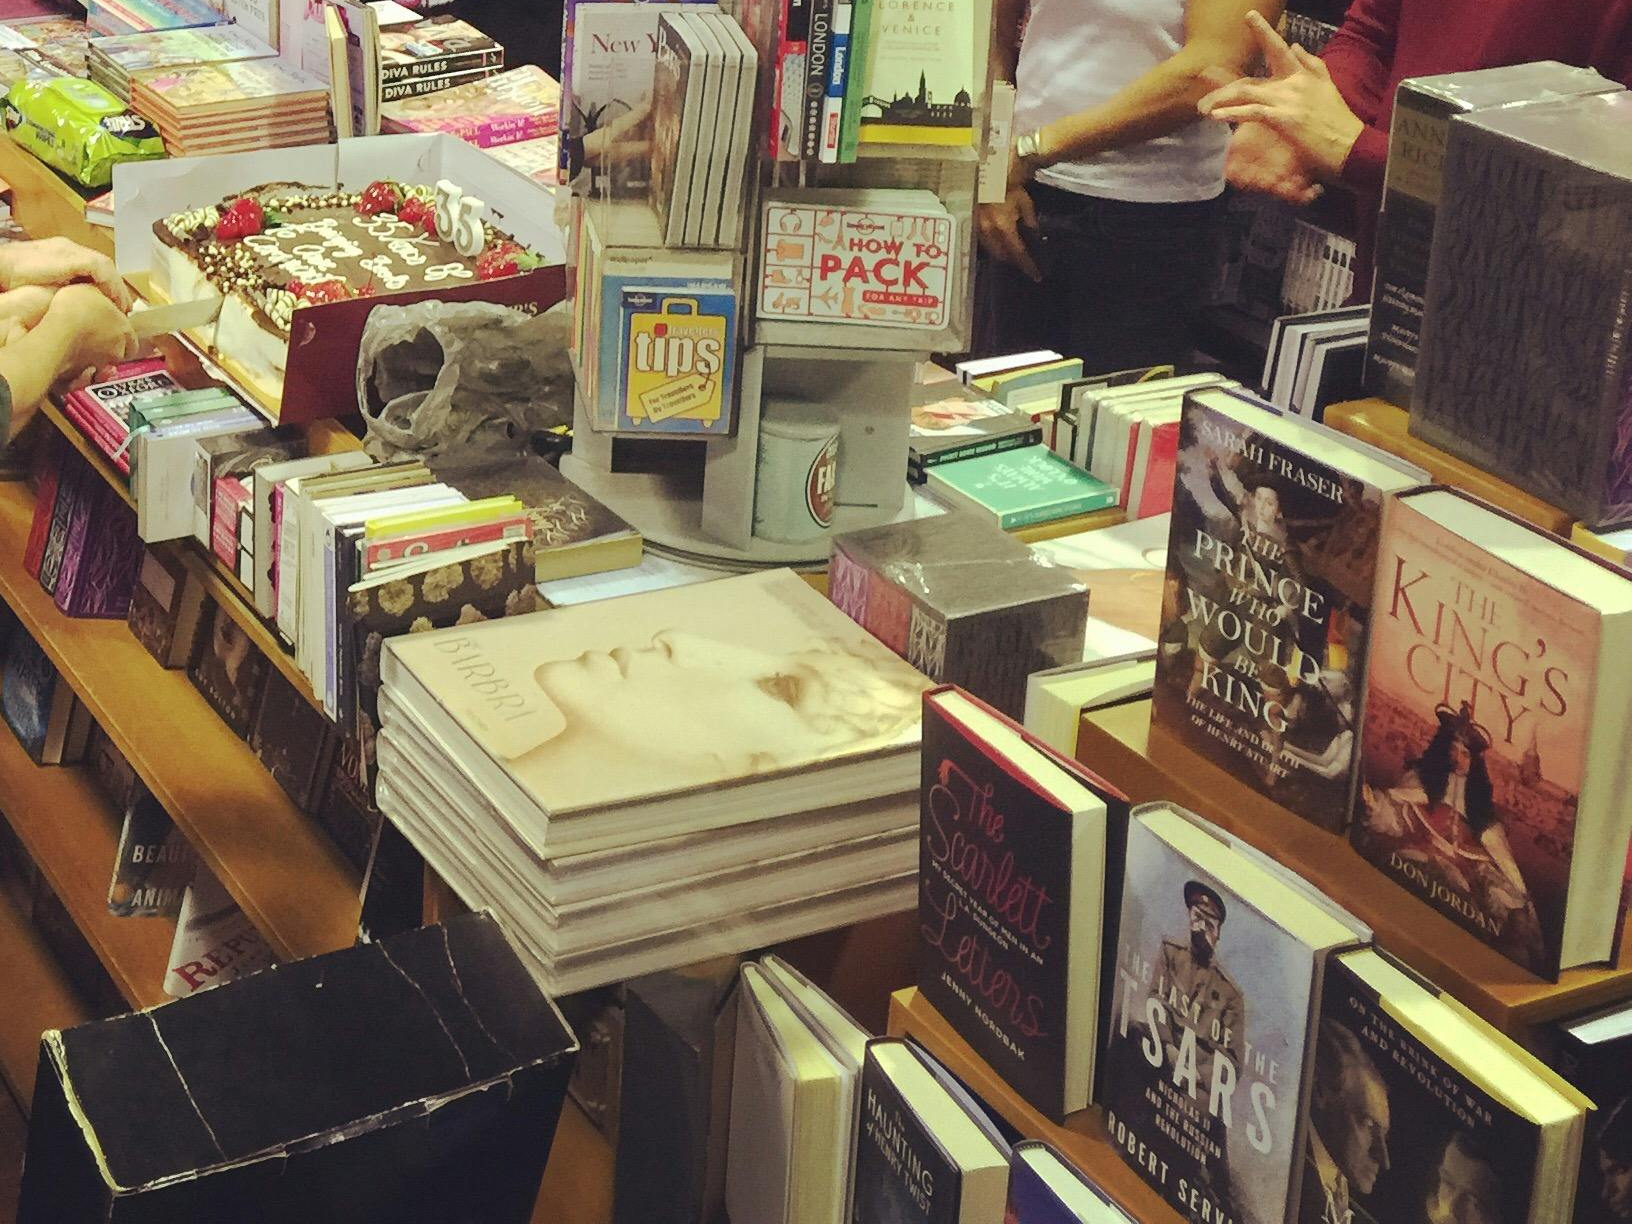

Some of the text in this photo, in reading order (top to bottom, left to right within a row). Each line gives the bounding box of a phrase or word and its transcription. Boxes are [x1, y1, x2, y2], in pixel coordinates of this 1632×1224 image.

[878, 0, 955, 12] LORENCE
[882, 26, 942, 36] VENICE
[381, 61, 448, 80] DIVA RULES
[592, 32, 641, 55] New
[810, 13, 829, 76] LONDON
[832, 46, 847, 85] London
[384, 79, 451, 99] DIVA RULES
[819, 253, 930, 289] PACK
[848, 237, 942, 259] HOW TO
[865, 293, 935, 305] FOR ANY TRIP
[635, 323, 721, 377] tips
[1202, 421, 1345, 505] SARAH FRASER
[1193, 530, 1326, 625] PRINCE
[1241, 525, 1285, 565] THE
[1186, 588, 1321, 685] WOULD
[1229, 587, 1283, 627] WHO
[1389, 554, 1568, 717] KING'S
[1455, 581, 1498, 625] THE
[1200, 662, 1289, 734] KING
[1234, 655, 1261, 678] BE
[1406, 643, 1532, 744] CITY
[939, 760, 1005, 843] The
[927, 784, 1053, 950] Scarlett
[1390, 852, 1500, 937] DON JORDAN
[921, 879, 1048, 1037] Letters
[1122, 942, 1150, 985] THE
[941, 971, 1026, 1062] JENNY NORDBAK
[1158, 975, 1280, 1086] LAST OF THE
[1119, 967, 1276, 1155] TSARS
[1348, 996, 1493, 1126] ON THE BRINK OF WAR
[1360, 1025, 1476, 1128] AND REVOLUTION
[1145, 1086, 1222, 1160] AND THE RUSSIAN
[1158, 1079, 1201, 1123] NICHOLAS
[867, 1088, 935, 1197] HAUNTING
[874, 1132, 903, 1176] HENRY
[904, 1174, 933, 1216] TWIST
[1108, 1109, 1169, 1185] ROBERT
[1155, 1112, 1208, 1167] REVOLUTION
